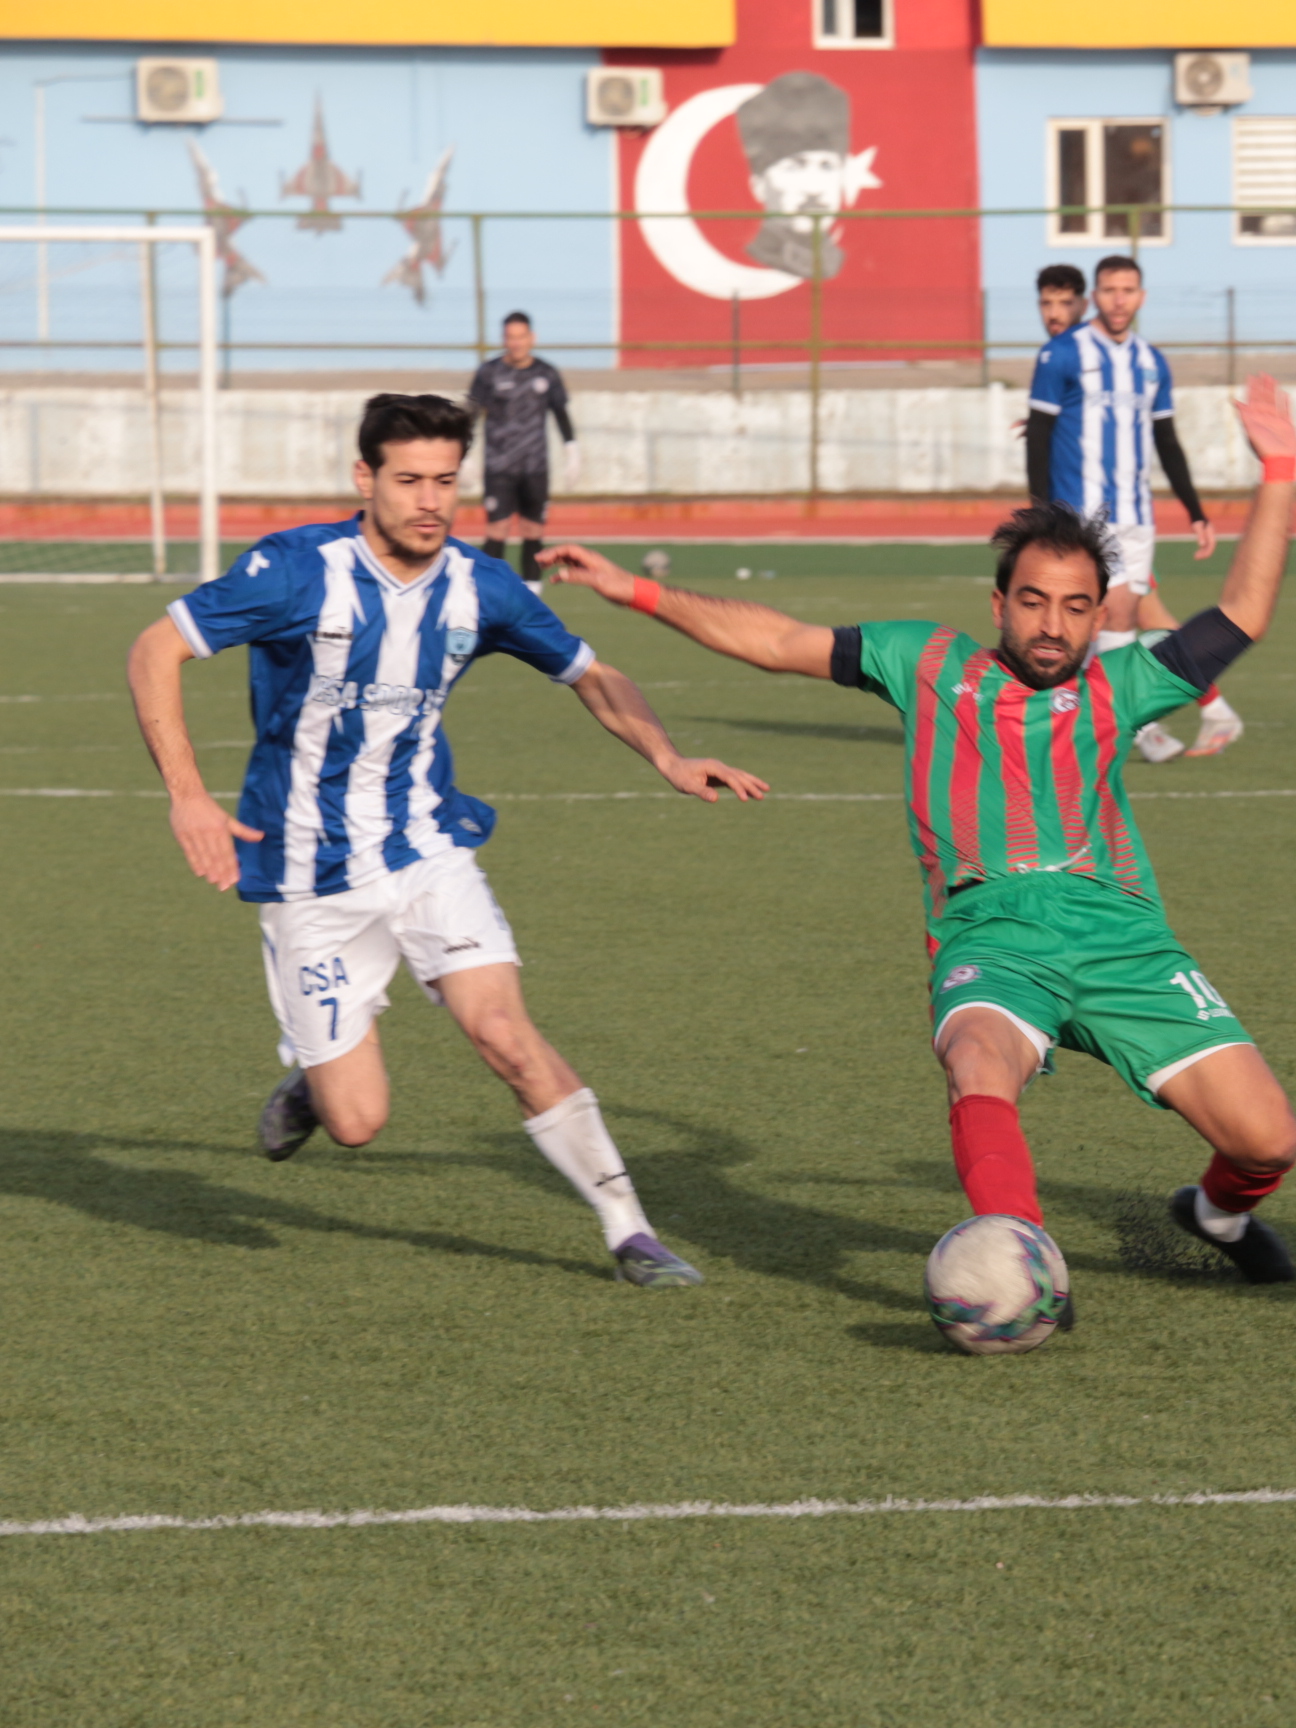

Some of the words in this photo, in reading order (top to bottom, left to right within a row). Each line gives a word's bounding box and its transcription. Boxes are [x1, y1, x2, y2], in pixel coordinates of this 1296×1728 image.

[299, 956, 350, 996] CSA
[1169, 970, 1227, 1009] 10
[319, 997, 338, 1041] 7
